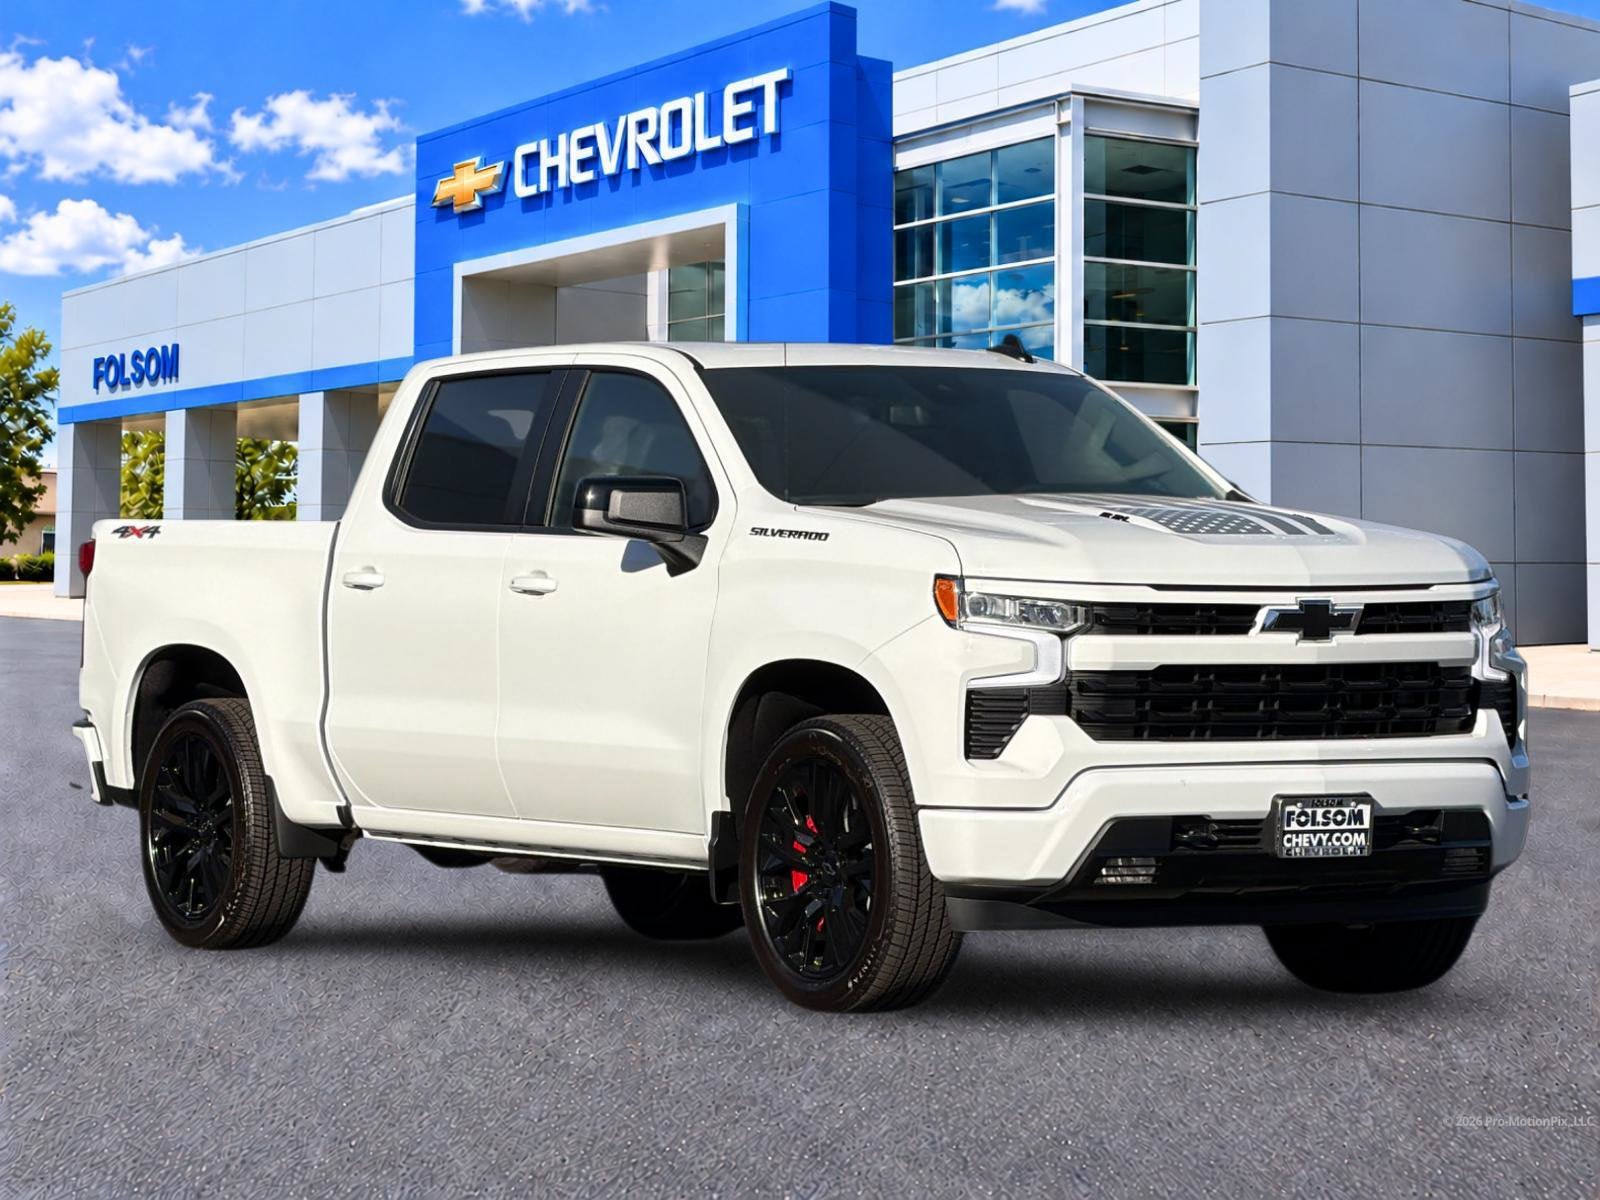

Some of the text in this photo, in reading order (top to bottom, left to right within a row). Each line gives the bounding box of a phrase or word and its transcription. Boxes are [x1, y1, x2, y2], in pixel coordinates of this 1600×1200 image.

[513, 67, 792, 199] CHEVROLET
[93, 343, 179, 390] FOLSOM
[749, 527, 830, 541] SILVERADO
[1285, 809, 1365, 828] FOLSOM
[1283, 832, 1366, 848] CHEVY.COM
[1284, 847, 1365, 857] CEVROLT
